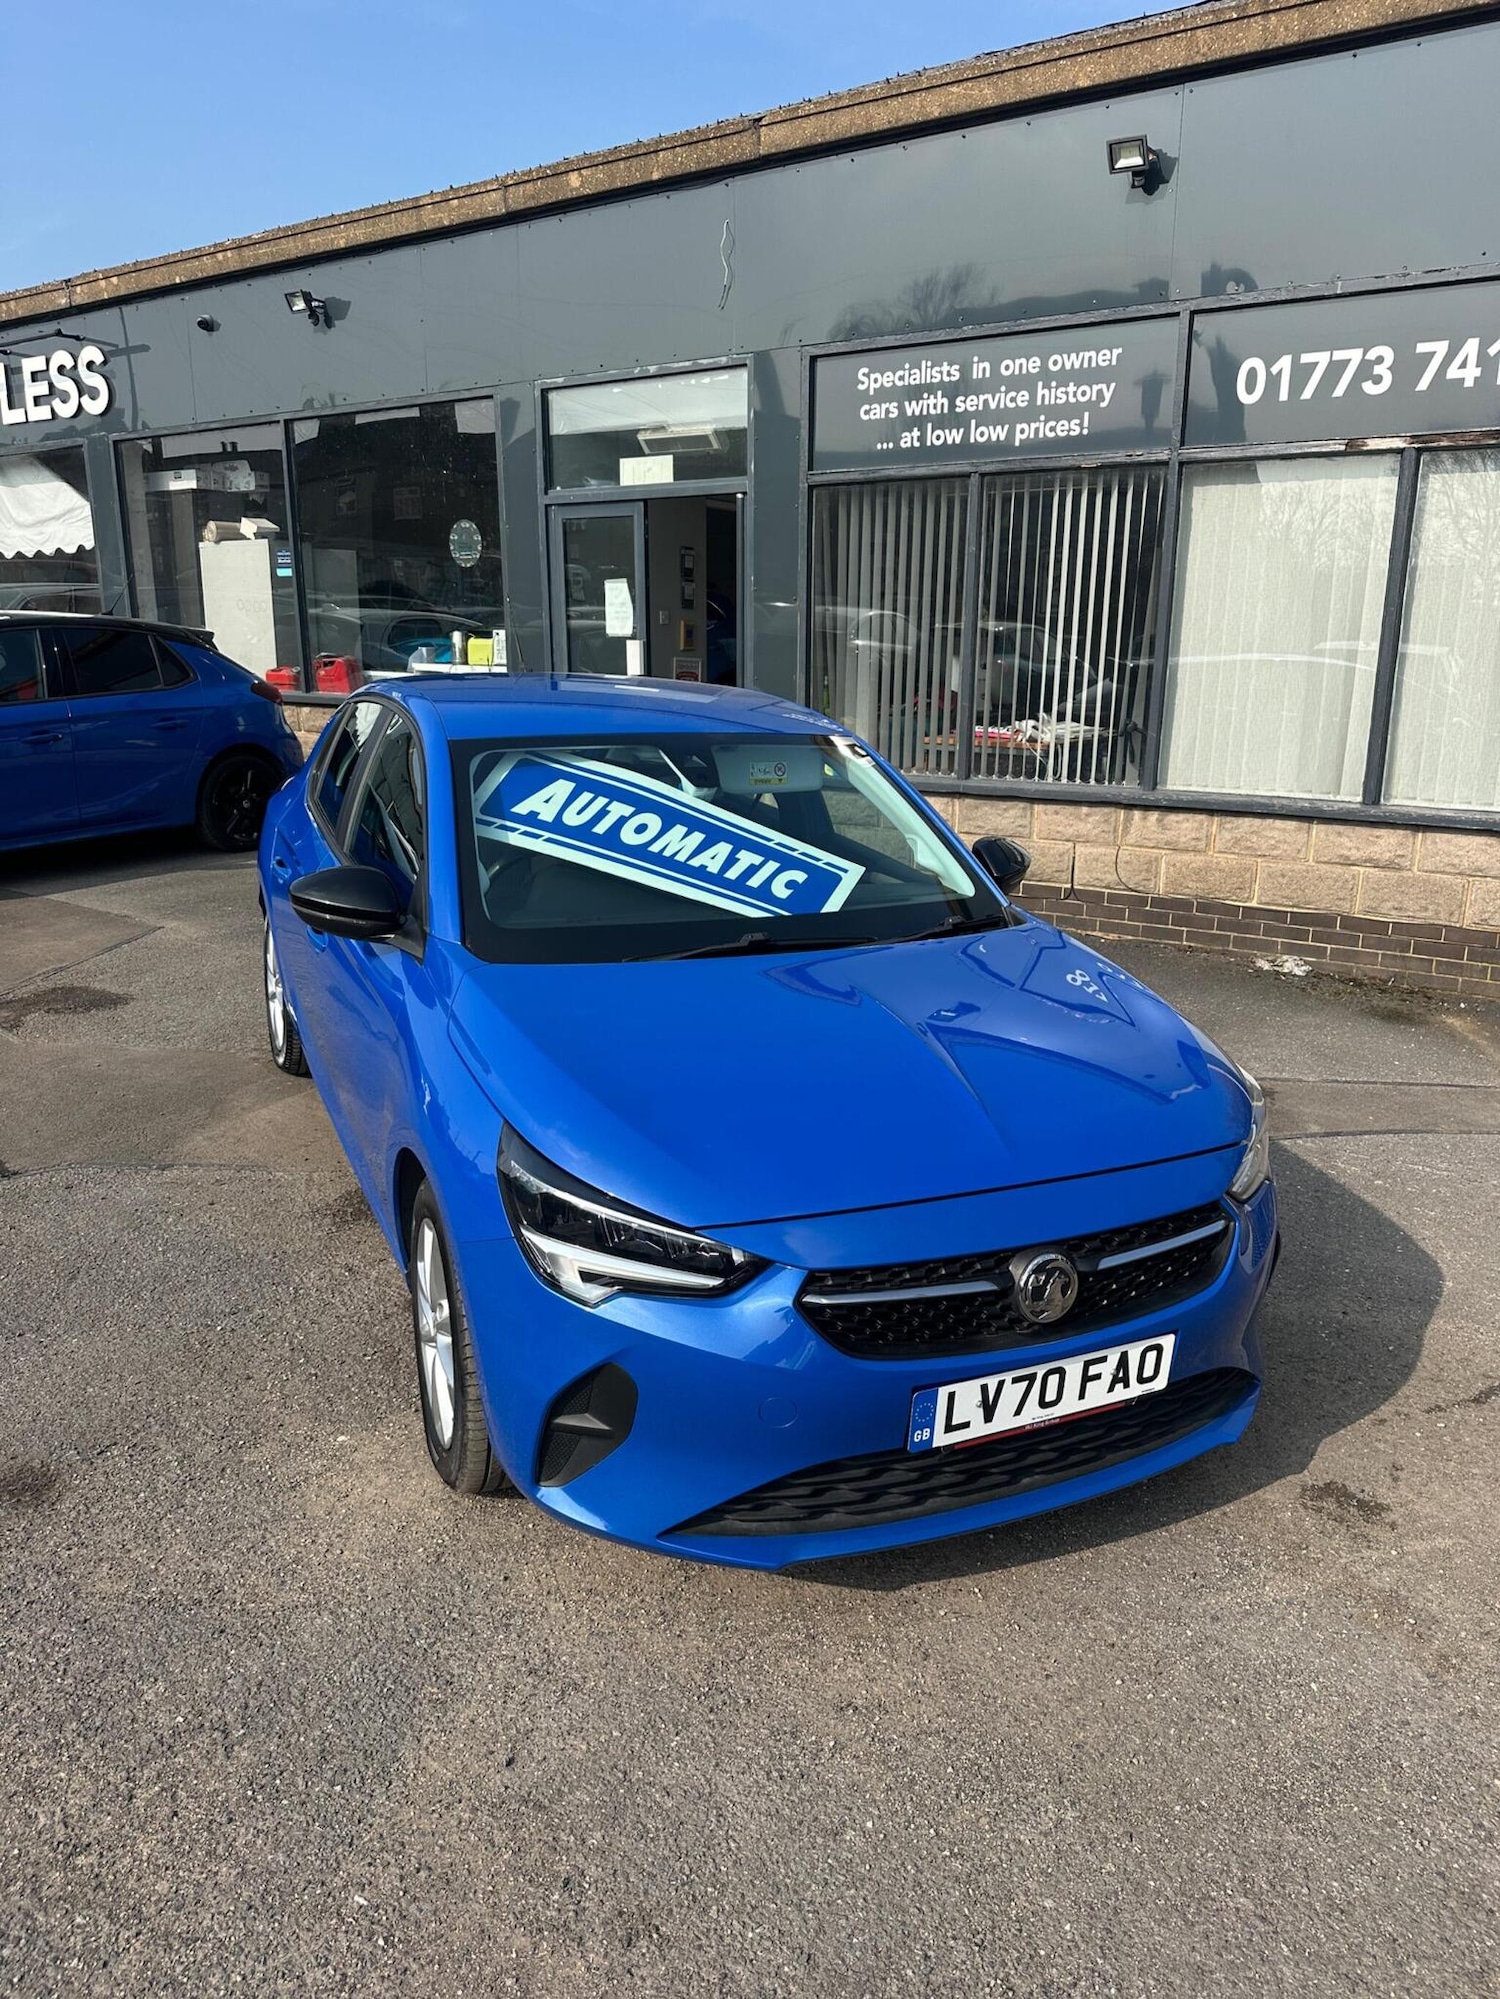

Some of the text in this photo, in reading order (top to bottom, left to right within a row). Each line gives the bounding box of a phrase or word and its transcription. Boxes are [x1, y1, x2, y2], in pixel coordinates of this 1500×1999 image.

[0, 345, 109, 425] LESS
[857, 347, 1123, 395] Specialists in one owner
[1236, 345, 1396, 405] 01773
[859, 381, 1117, 420] cars with service history
[899, 427, 921, 449] at
[926, 422, 965, 446] low
[969, 419, 1010, 443] low
[1014, 412, 1090, 446] prices!
[510, 778, 808, 899] AUTOMATIC
[943, 1343, 1165, 1435] LV70 FAO
[913, 1427, 931, 1442] GB
